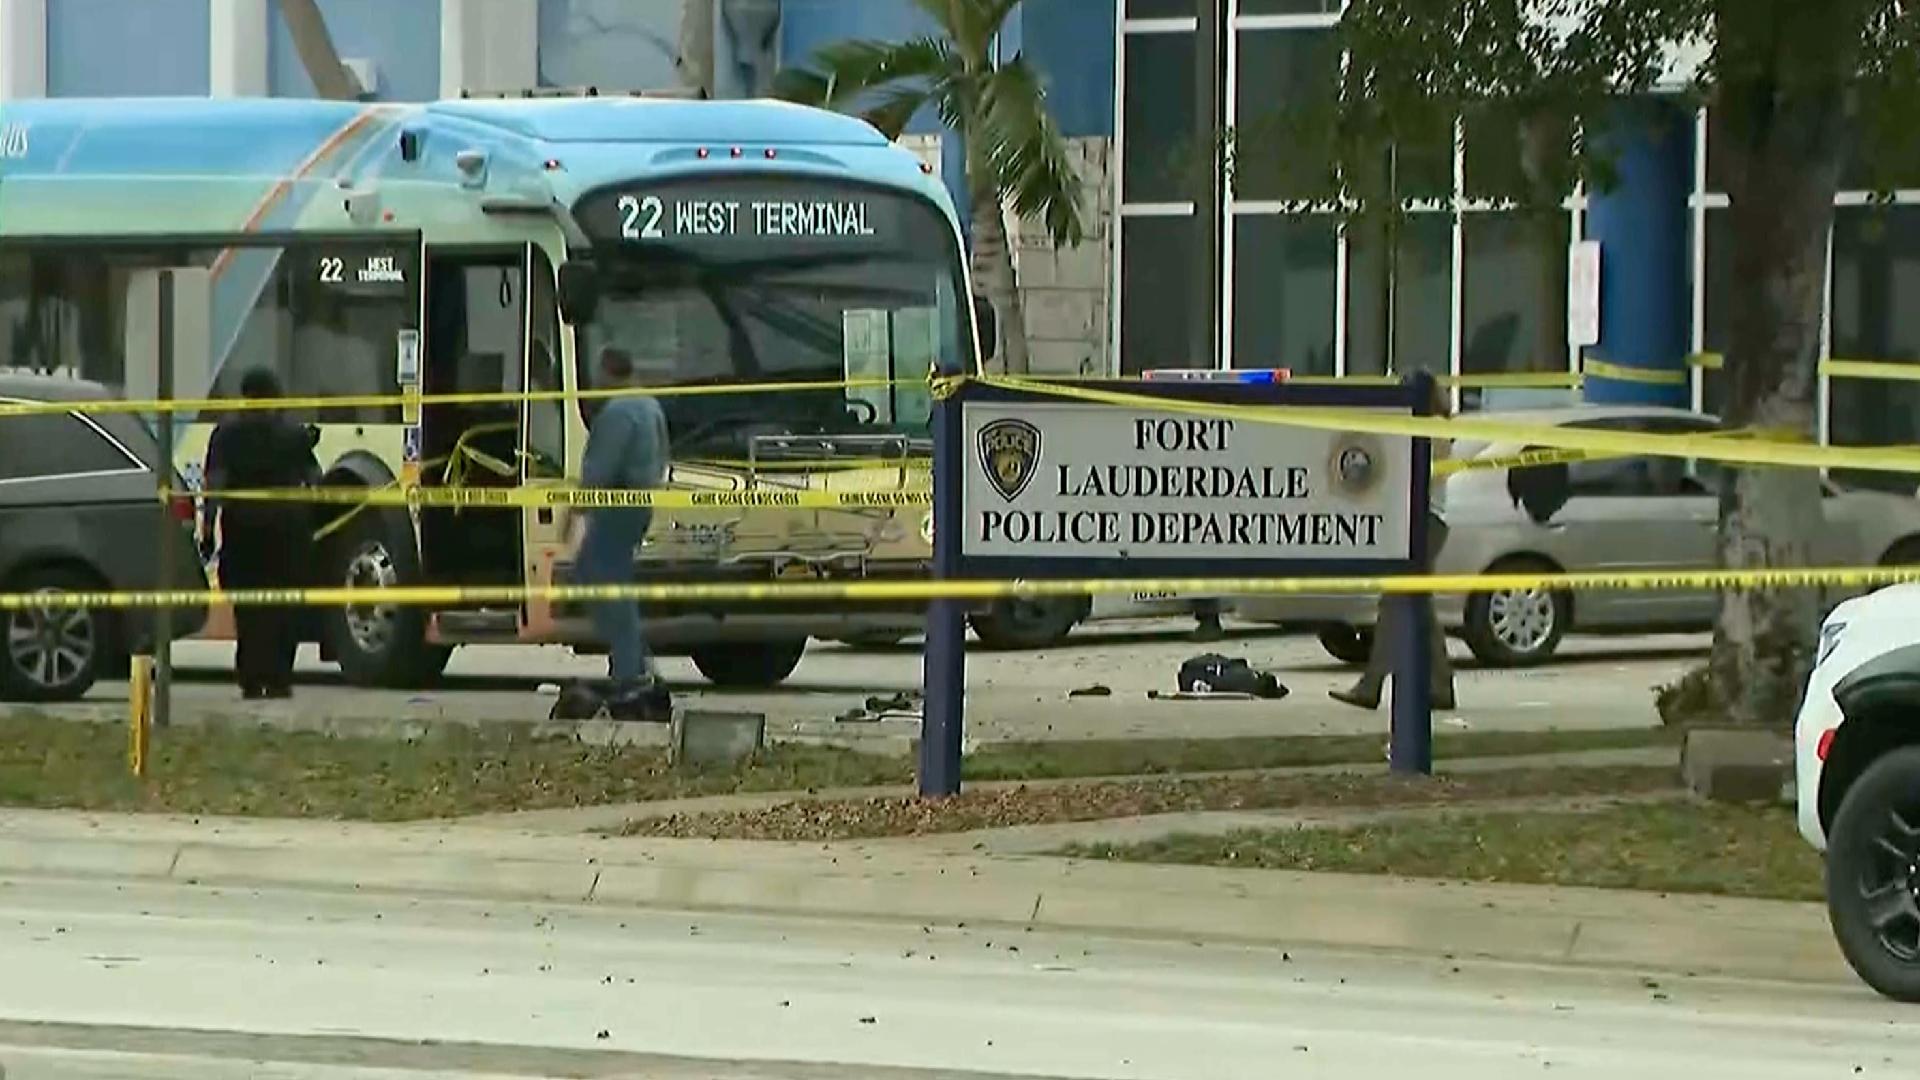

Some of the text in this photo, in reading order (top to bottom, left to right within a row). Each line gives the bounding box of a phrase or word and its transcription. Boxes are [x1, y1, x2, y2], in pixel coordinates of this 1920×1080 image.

[618, 195, 874, 238] 22 WEST TERMINAL
[319, 257, 343, 282] 22
[1134, 418, 1234, 451] FORT
[1057, 464, 1310, 499] LAUDERDALE
[980, 510, 1384, 546] POLICE DEPARTMENT
